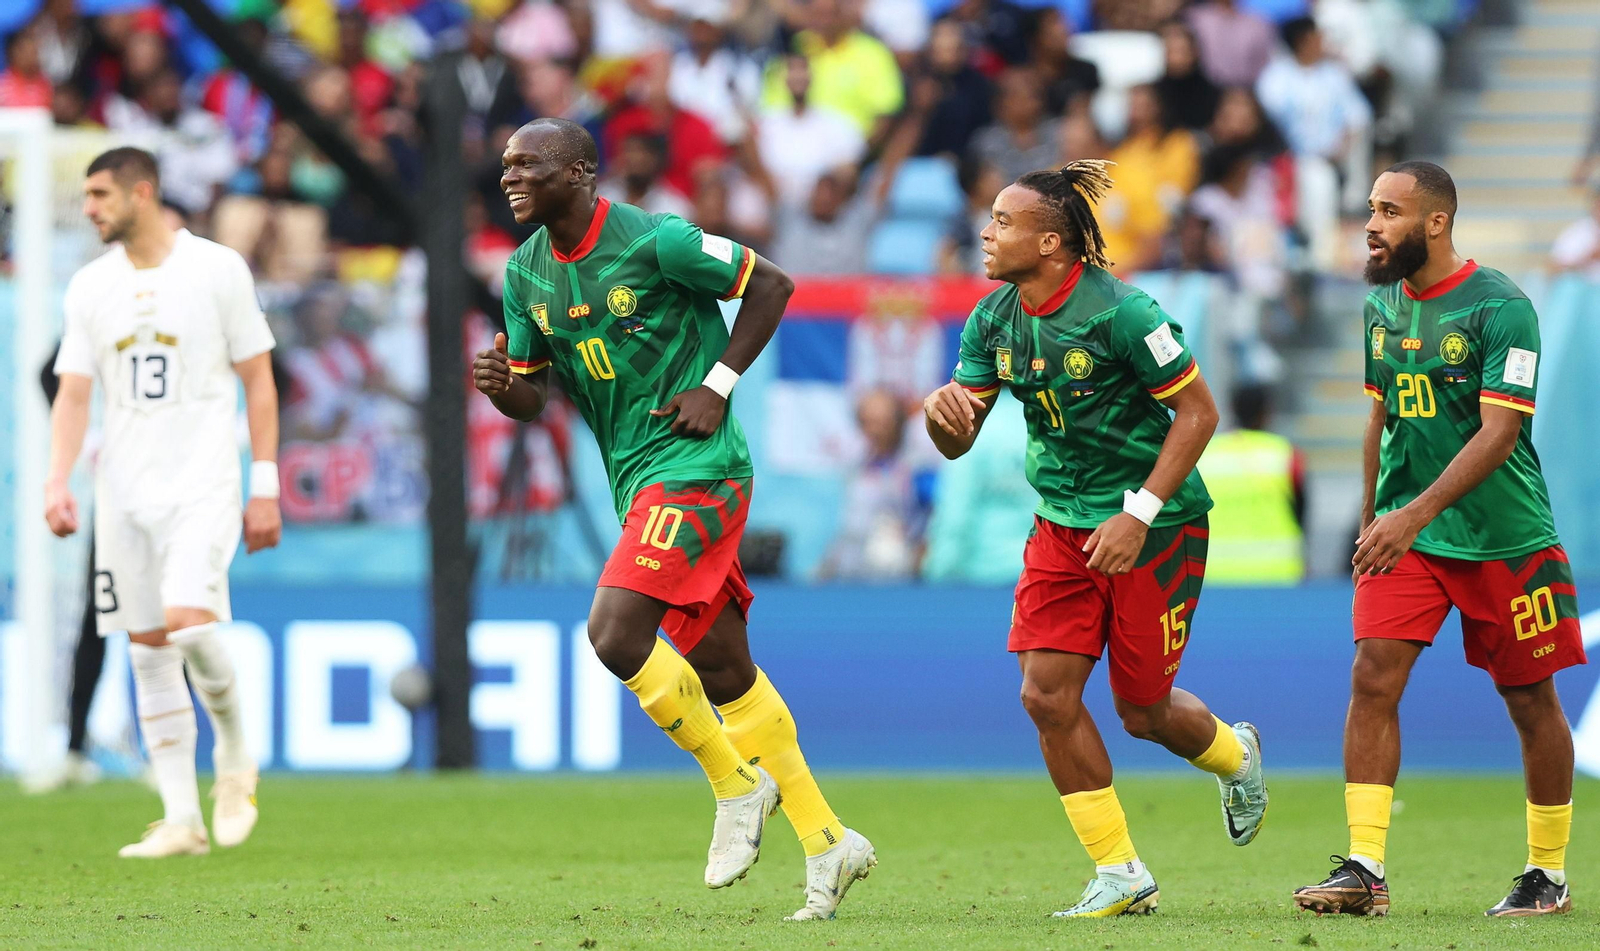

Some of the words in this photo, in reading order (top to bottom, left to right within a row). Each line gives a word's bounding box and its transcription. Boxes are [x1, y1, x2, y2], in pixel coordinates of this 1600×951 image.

[568, 304, 591, 318] one
[575, 338, 616, 381] 10
[1031, 359, 1046, 371] one
[1400, 338, 1423, 350] one
[131, 355, 167, 399] 13
[1396, 373, 1437, 418] 20
[640, 505, 684, 550] 10
[635, 555, 661, 571] one
[94, 569, 119, 614] 3
[1160, 602, 1186, 656] 15
[1510, 586, 1558, 641] 20
[1533, 643, 1556, 659] one
